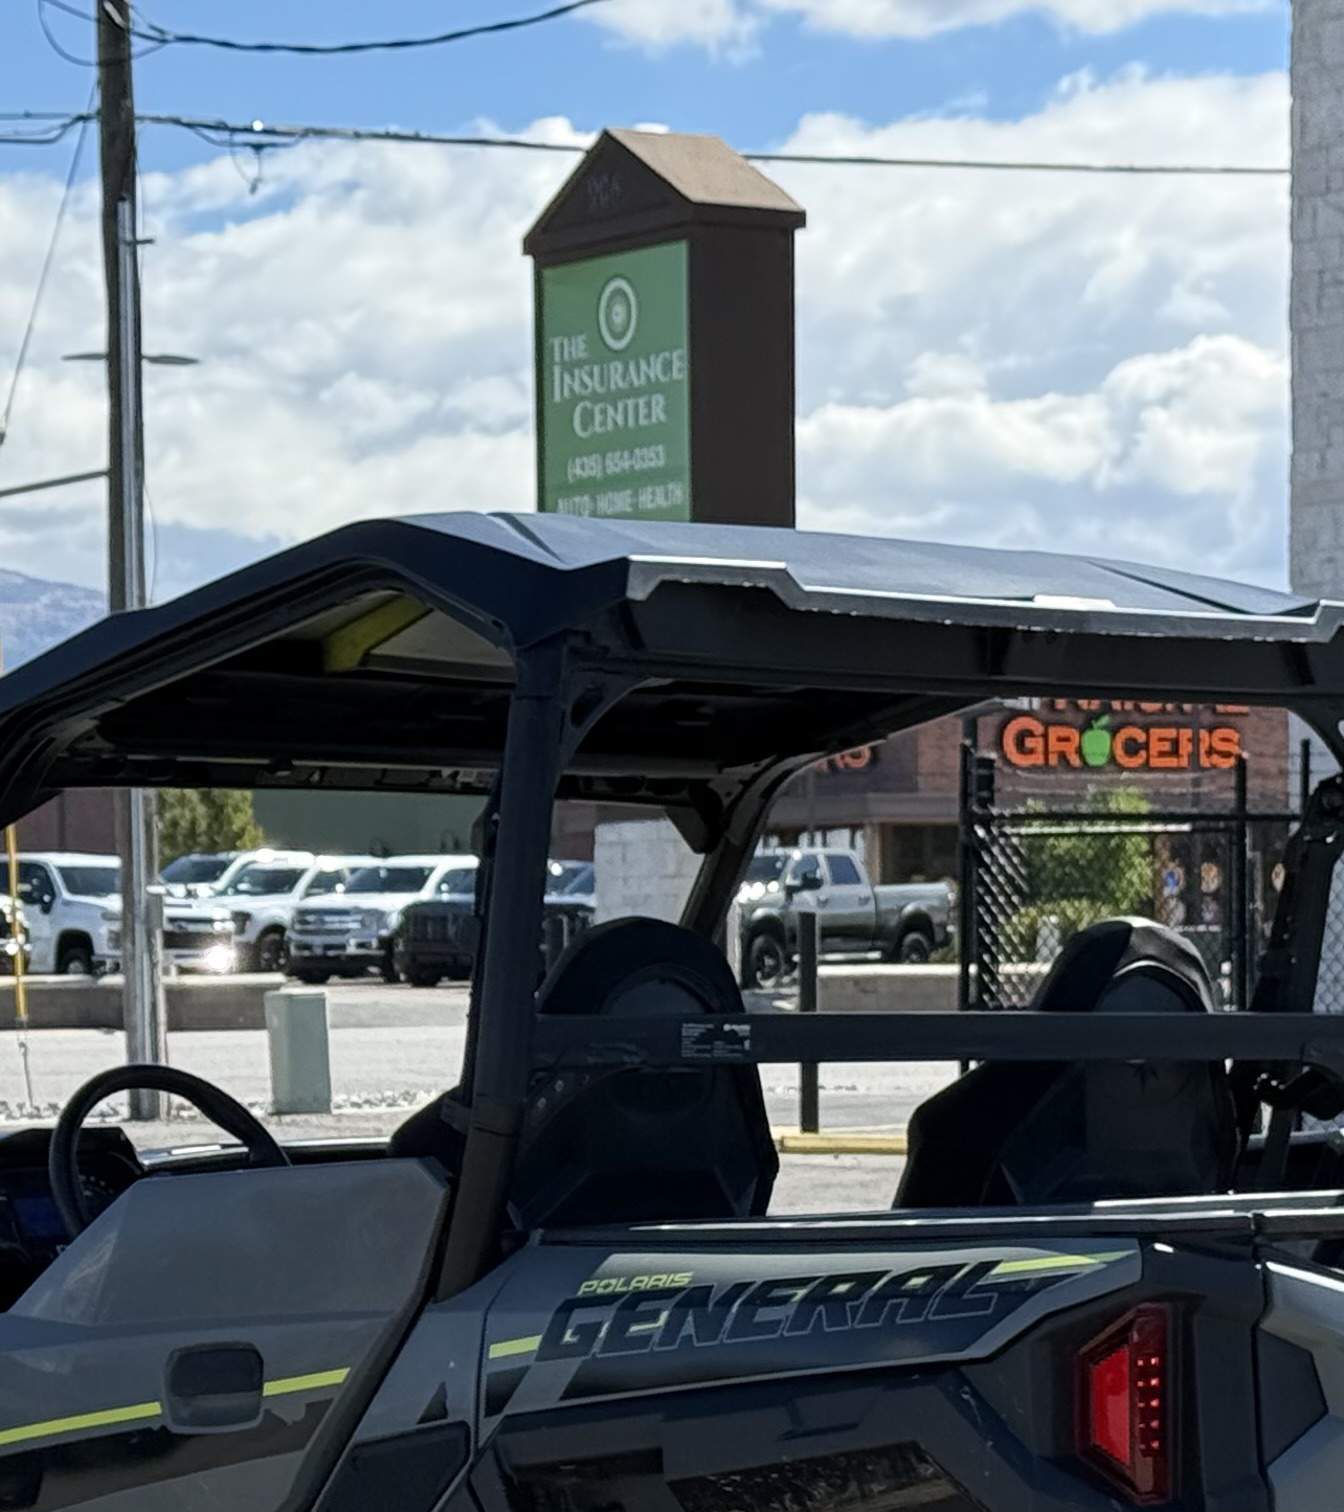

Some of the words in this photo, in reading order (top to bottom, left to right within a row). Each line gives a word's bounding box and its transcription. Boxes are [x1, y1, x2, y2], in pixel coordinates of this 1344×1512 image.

[550, 334, 587, 363] THE
[553, 350, 685, 402] INSURANCE
[573, 393, 667, 438] CENTER
[577, 1271, 693, 1296] POLARIS
[535, 1260, 1006, 1362] GENERAL
